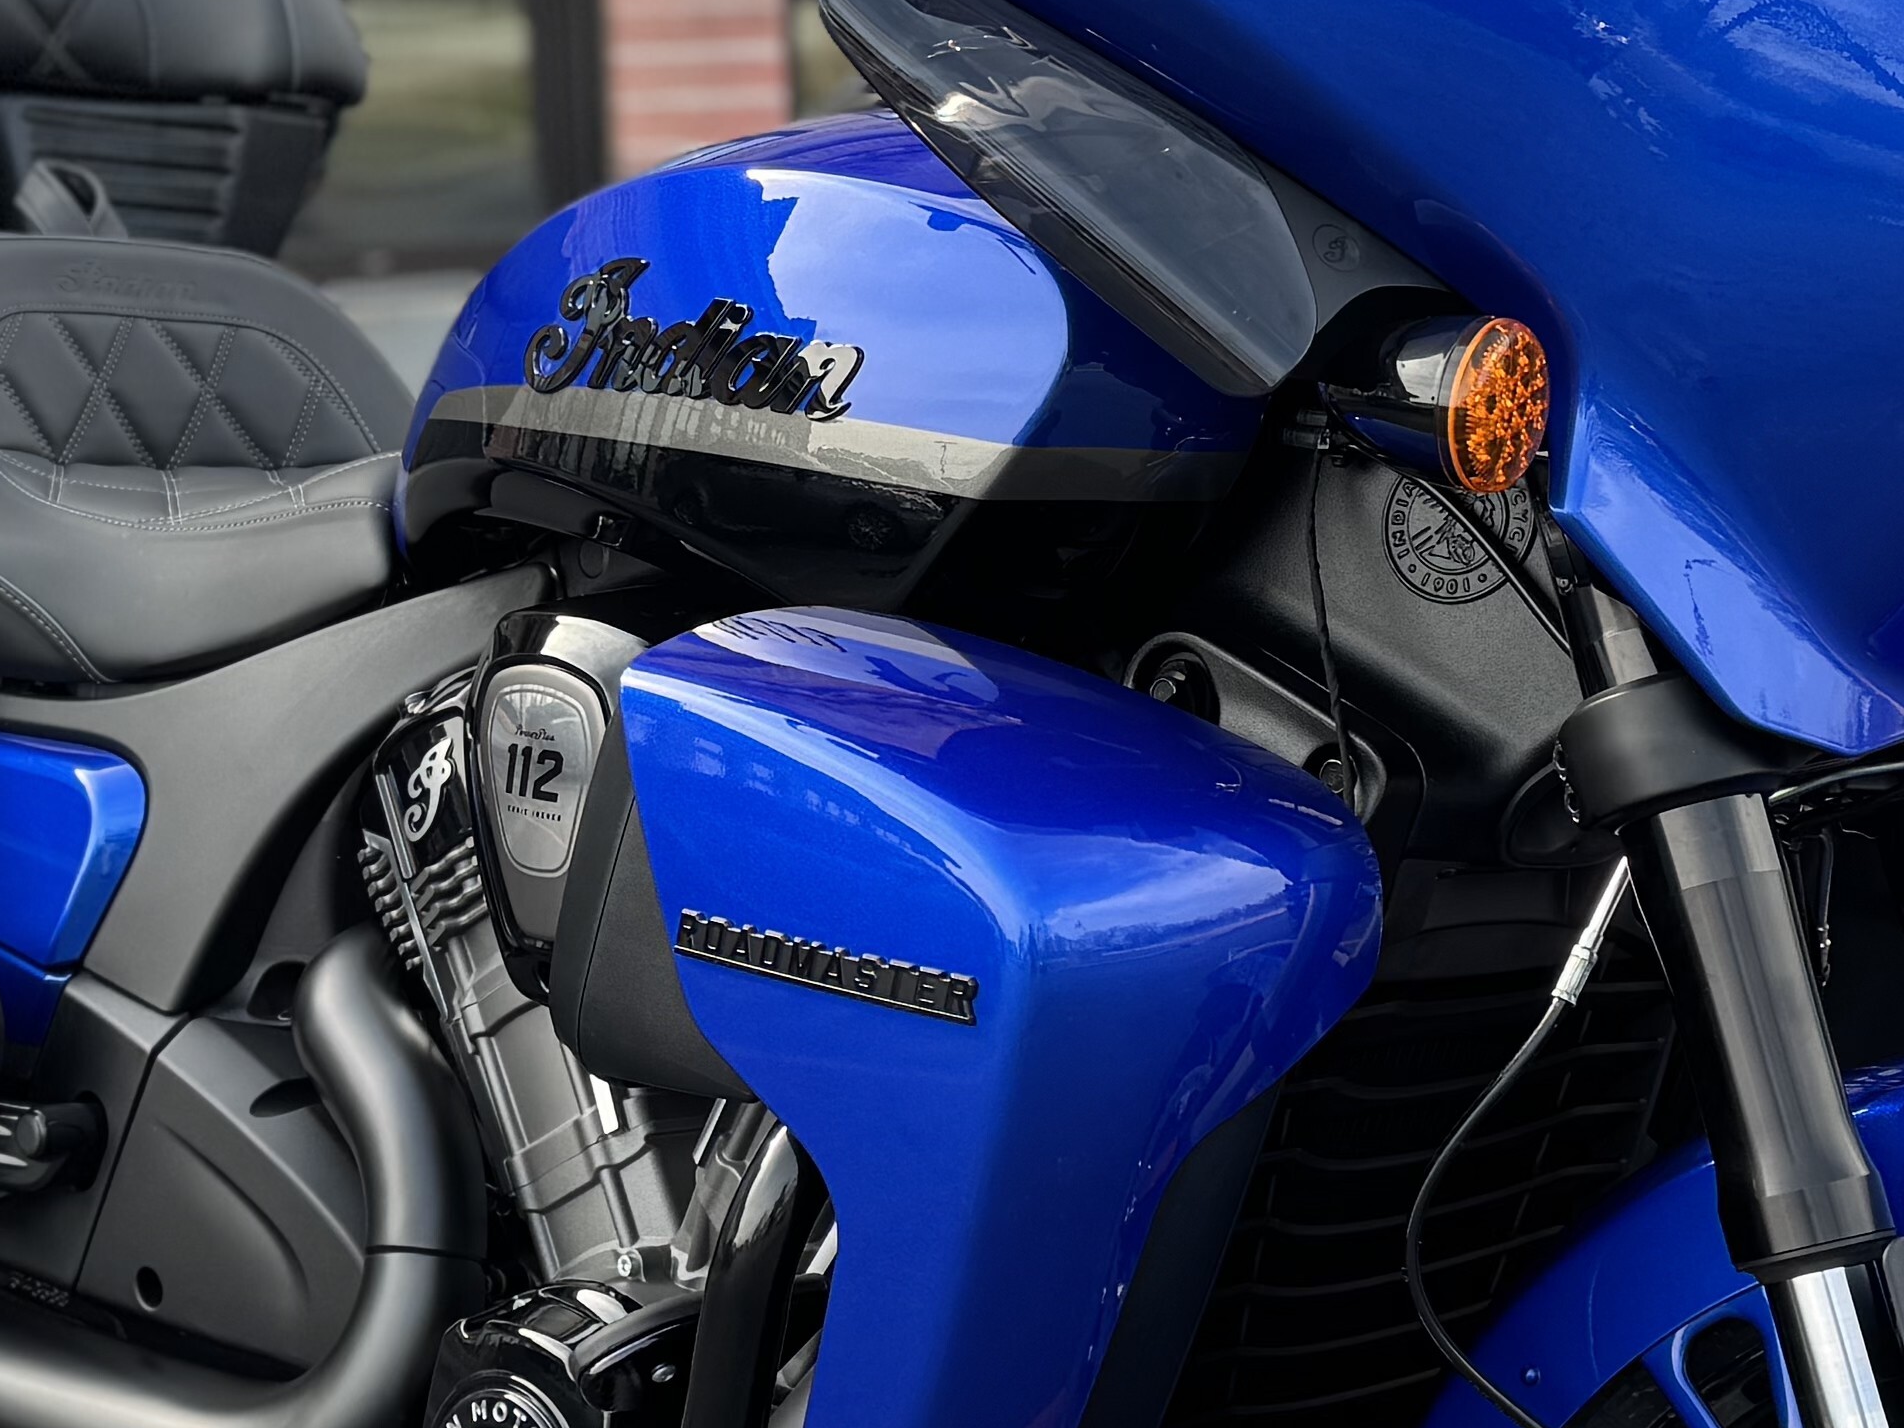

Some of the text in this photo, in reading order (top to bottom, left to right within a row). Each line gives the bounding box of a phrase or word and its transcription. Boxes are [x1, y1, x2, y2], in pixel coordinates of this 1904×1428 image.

[524, 257, 866, 422] Indian
[1391, 480, 1417, 561] INDIA
[1419, 571, 1472, 596] 1901
[505, 743, 564, 803] 112
[675, 907, 978, 1025] ROADMASTER
